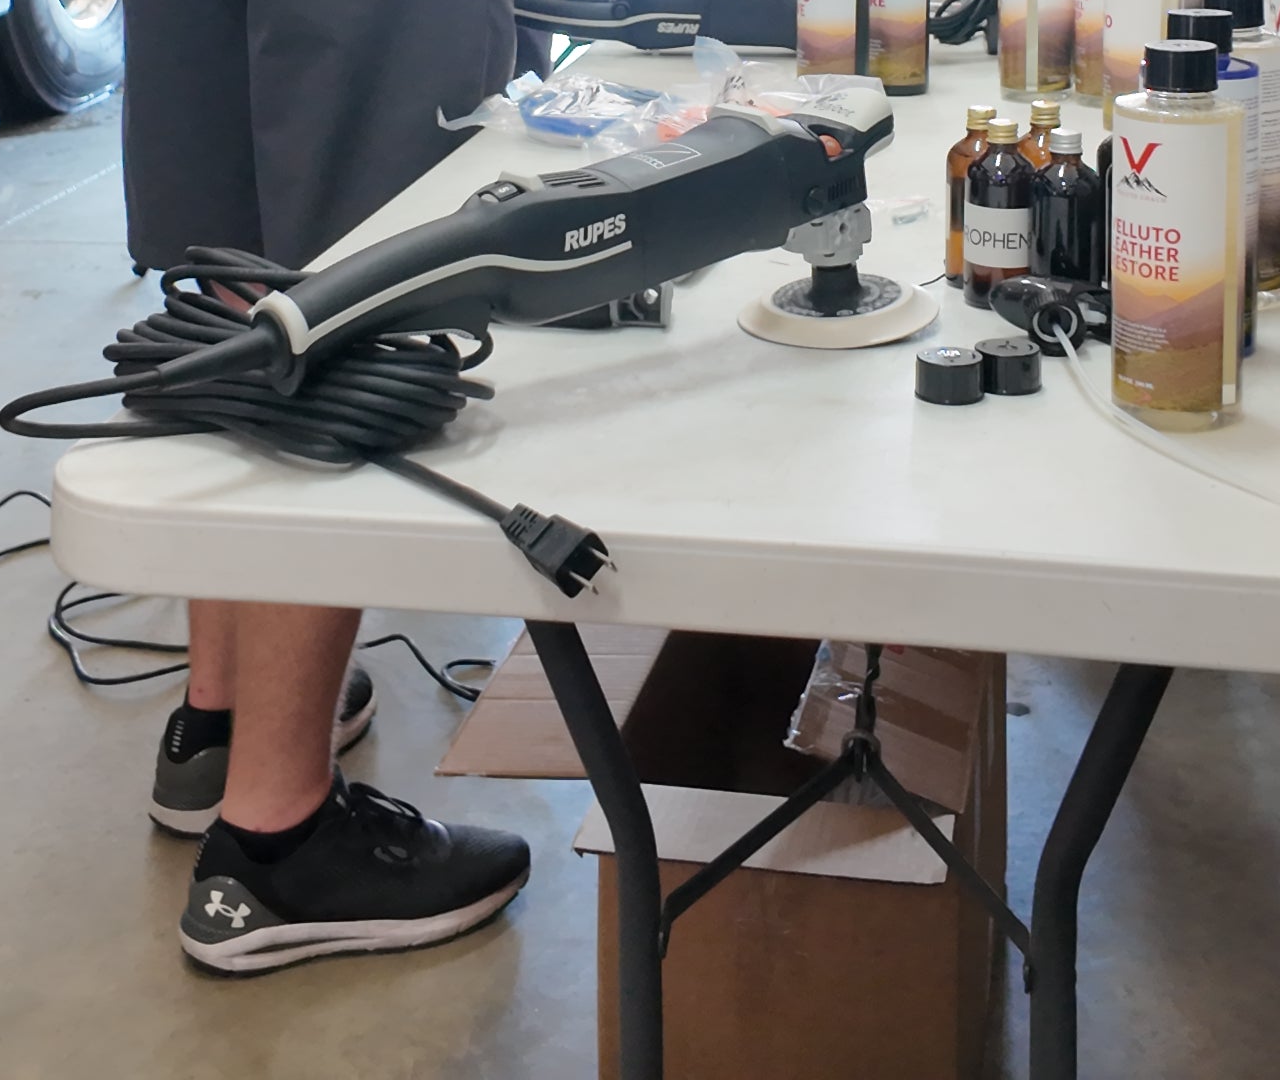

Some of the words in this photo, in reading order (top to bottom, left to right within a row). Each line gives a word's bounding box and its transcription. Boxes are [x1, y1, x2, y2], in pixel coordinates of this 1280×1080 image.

[564, 213, 627, 252] RUPES
[1115, 217, 1182, 245] ELLUTO
[1115, 236, 1180, 264] EATHER
[1115, 254, 1180, 282] ESTORE
